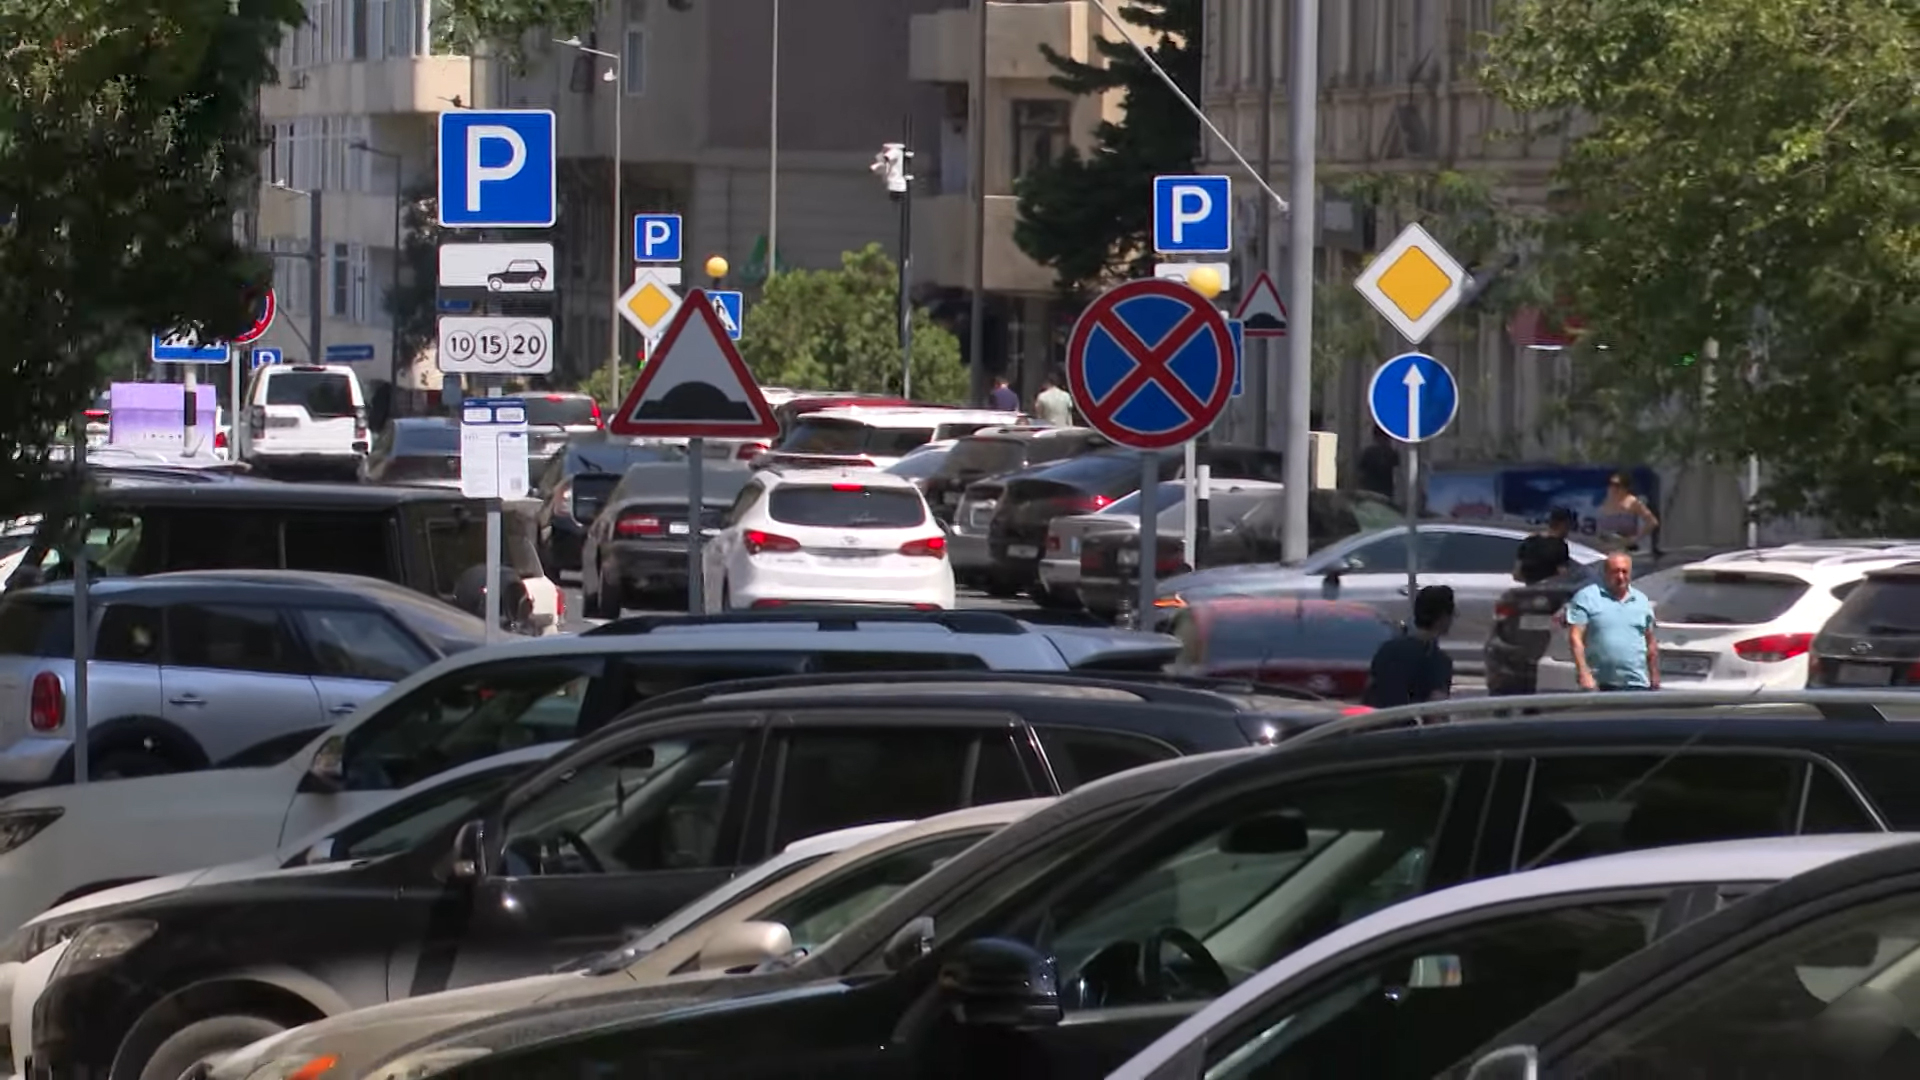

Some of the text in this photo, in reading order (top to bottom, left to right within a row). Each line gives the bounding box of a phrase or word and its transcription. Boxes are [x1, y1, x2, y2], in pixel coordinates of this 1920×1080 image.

[467, 125, 526, 211] P
[1172, 185, 1212, 243] P
[645, 220, 671, 256] P
[451, 334, 541, 355] 10 15 20
